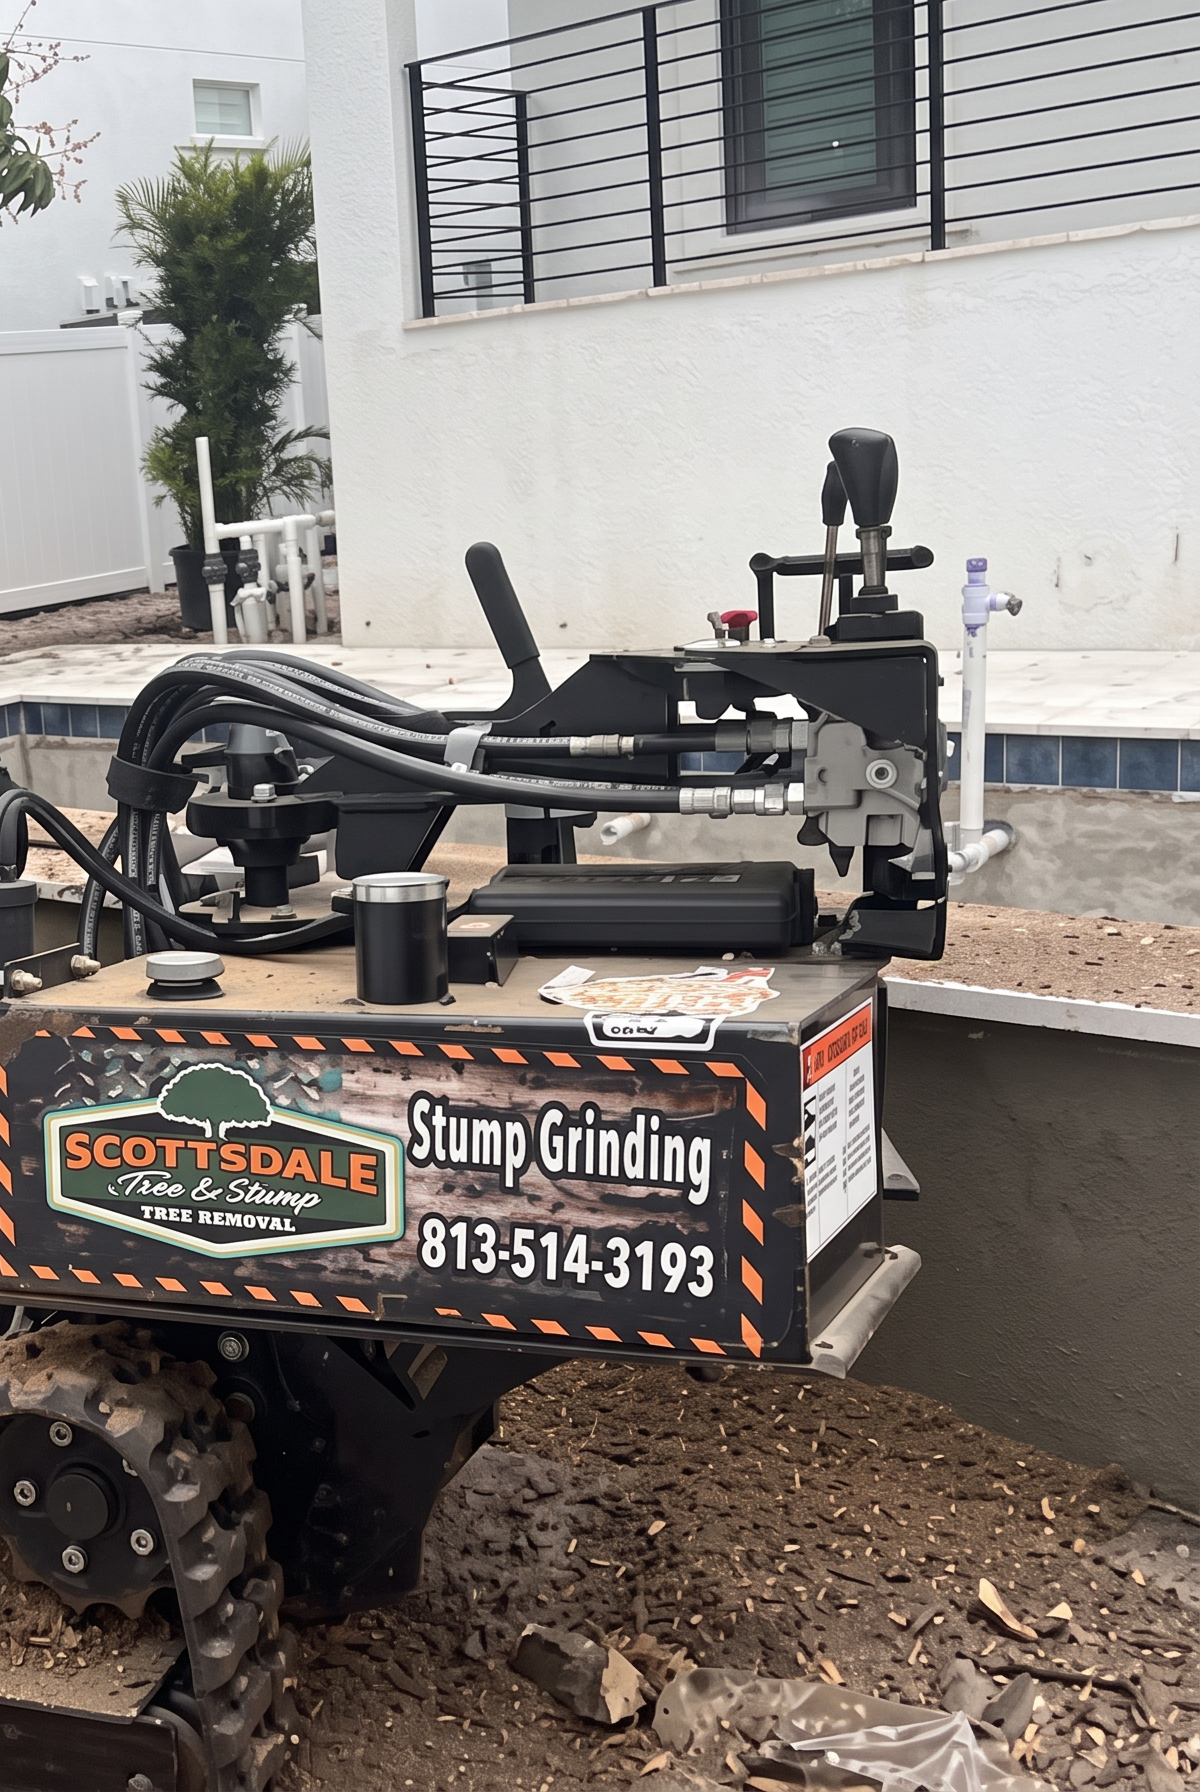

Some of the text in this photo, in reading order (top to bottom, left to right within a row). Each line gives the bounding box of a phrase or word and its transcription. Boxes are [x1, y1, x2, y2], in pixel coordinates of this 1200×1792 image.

[64, 1132, 379, 1196] SCOTTSDALE
[411, 1097, 527, 1188] Stump
[540, 1108, 712, 1206] Grinding
[108, 1170, 321, 1215] Tree & Stump
[141, 1205, 296, 1232] TREE REMOVAL
[421, 1217, 714, 1298] 813-514-3193
